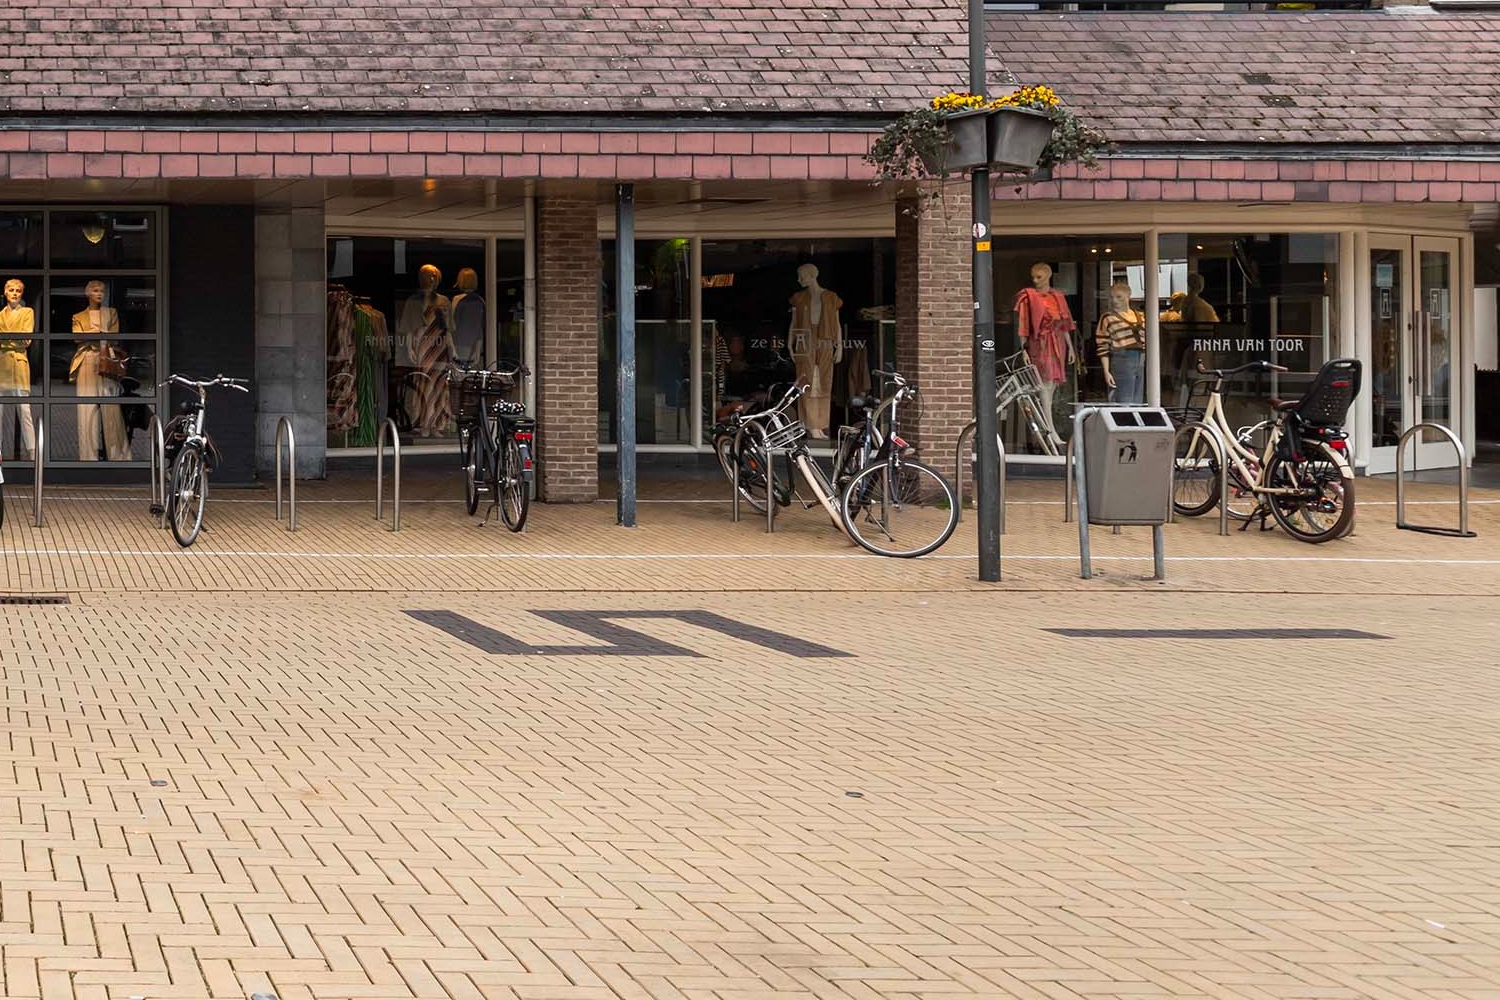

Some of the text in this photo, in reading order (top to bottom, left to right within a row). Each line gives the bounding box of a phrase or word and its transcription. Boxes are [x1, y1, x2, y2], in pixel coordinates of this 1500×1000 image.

[364, 335, 394, 346] ANNA
[750, 338, 768, 349] ze
[772, 335, 785, 349] is
[1193, 338, 1304, 352] ANNA VAN TOOR
